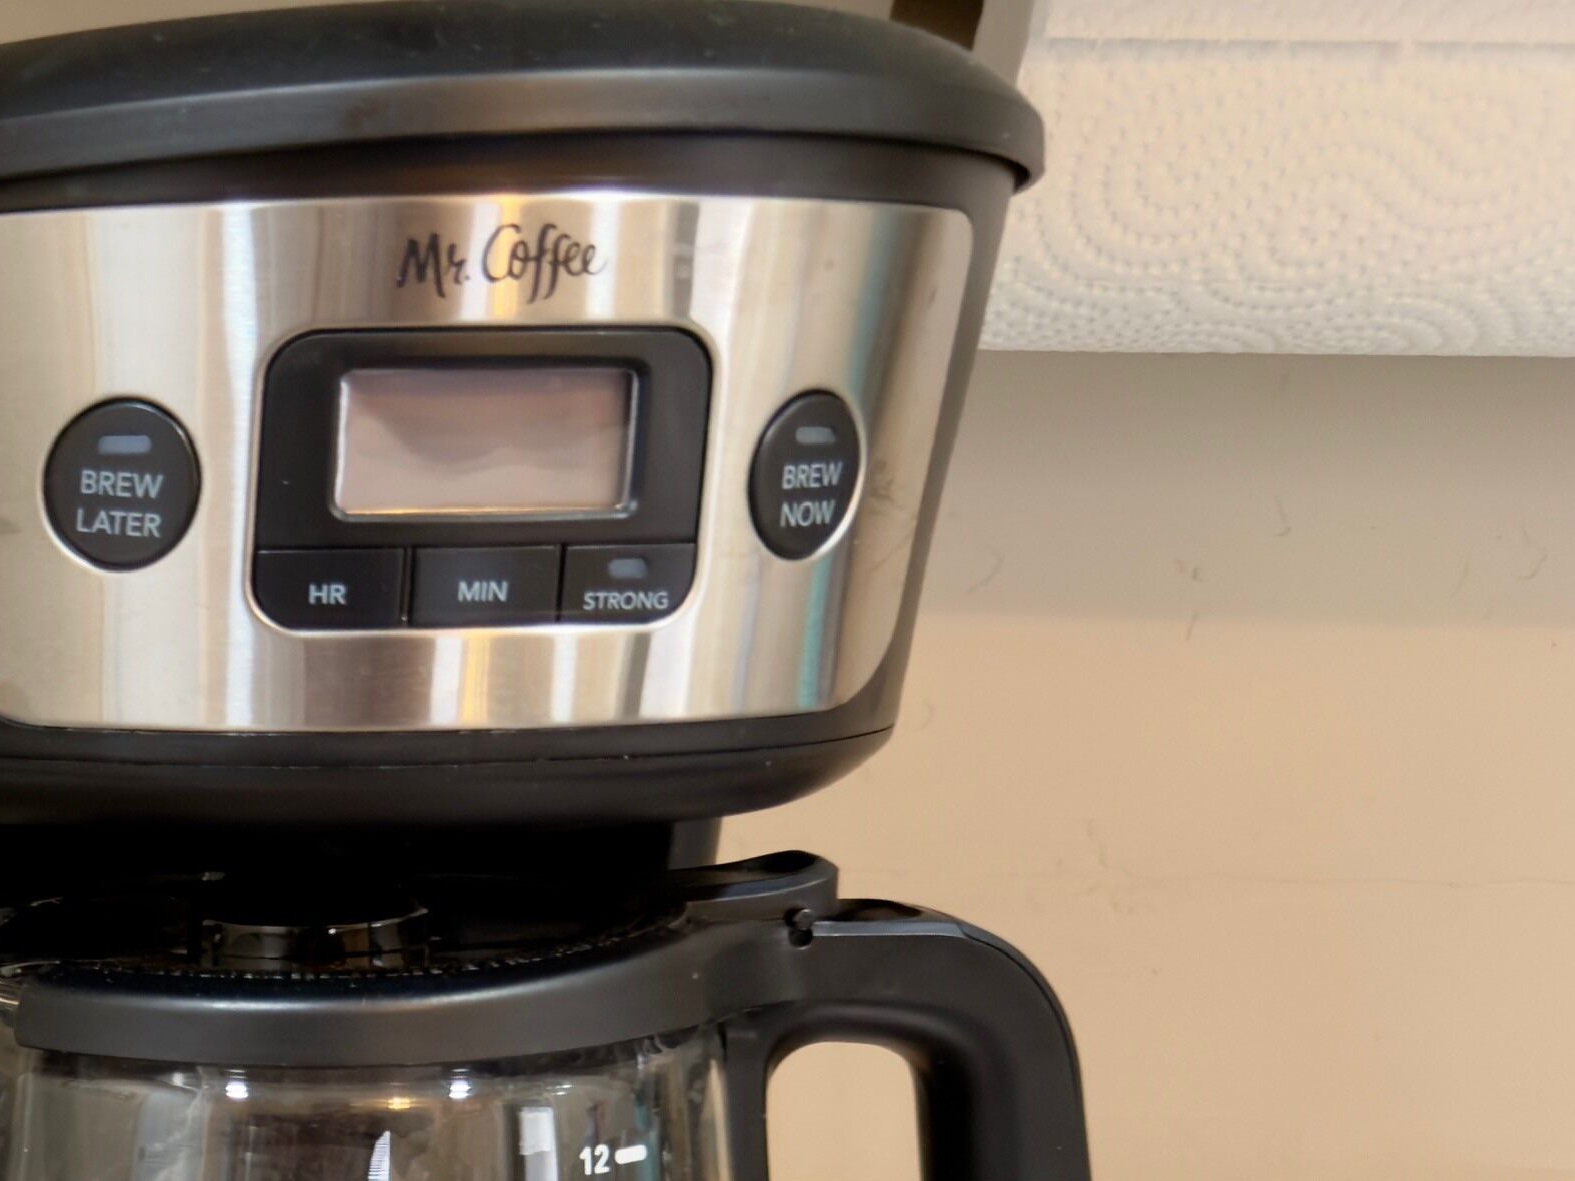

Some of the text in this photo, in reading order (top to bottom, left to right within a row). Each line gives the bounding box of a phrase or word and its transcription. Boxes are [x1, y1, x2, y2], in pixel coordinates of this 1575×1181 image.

[395, 222, 607, 305] Mr. Coffee
[80, 468, 164, 499] BREW
[781, 461, 844, 490] BREW
[76, 507, 162, 538] LATER
[780, 499, 836, 528] NOW
[308, 583, 348, 606] HR
[457, 580, 508, 603] MIN
[582, 591, 670, 612] STRONG
[578, 1143, 611, 1176] 12
